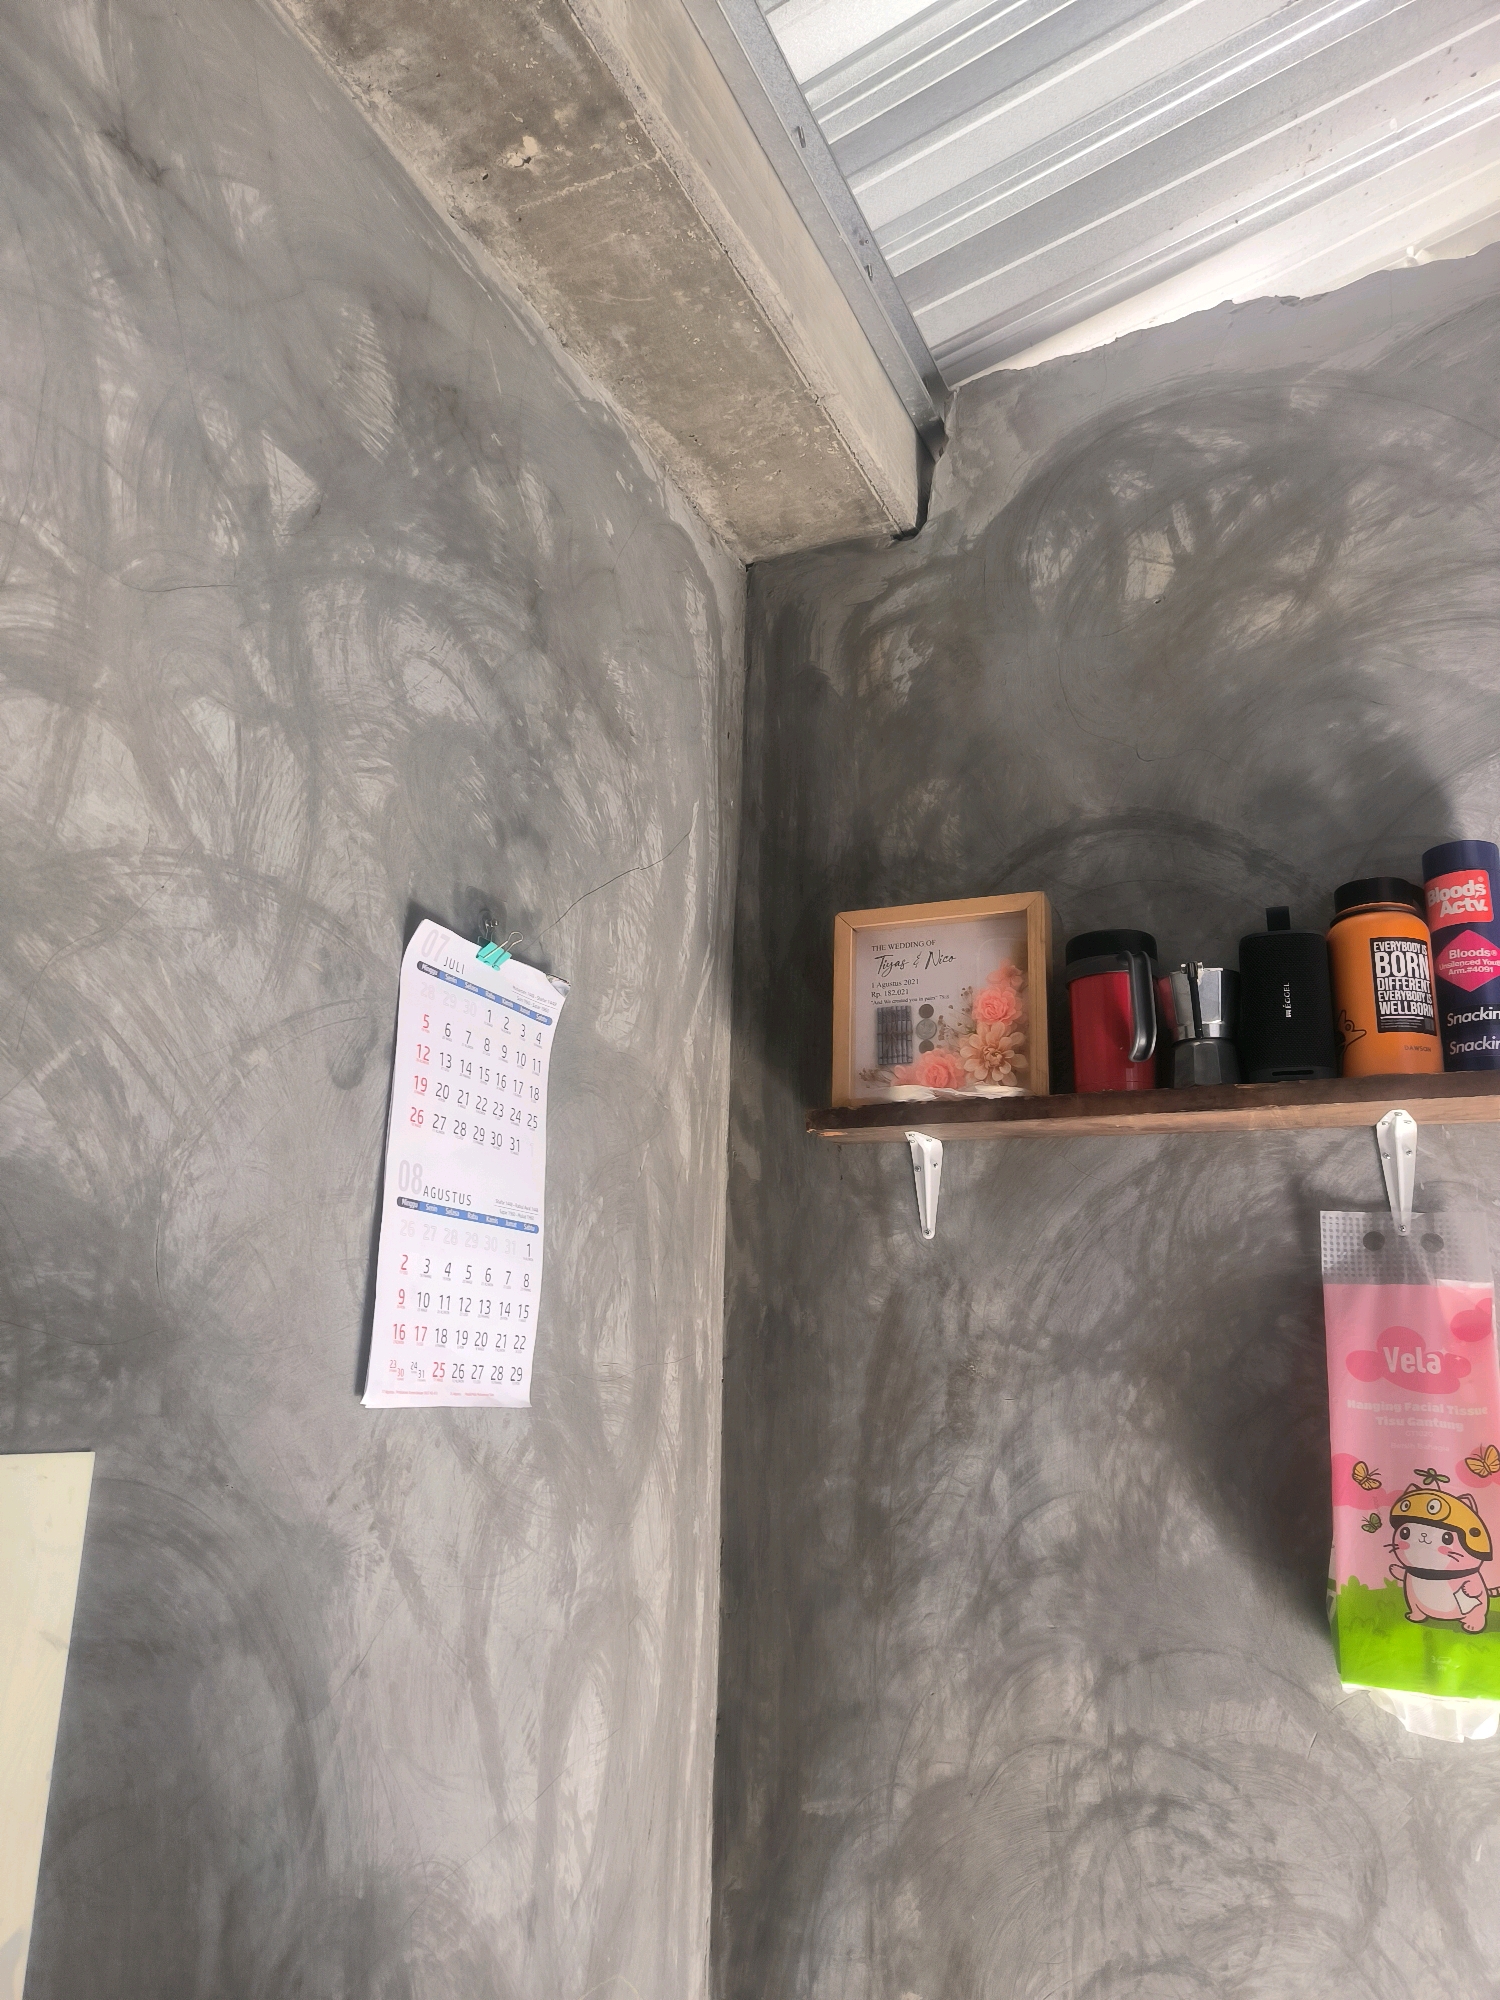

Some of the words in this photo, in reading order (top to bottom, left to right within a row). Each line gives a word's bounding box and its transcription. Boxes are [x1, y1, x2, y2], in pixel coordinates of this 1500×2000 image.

[421, 929, 450, 962] 07
[888, 941, 924, 950] WEDDING
[1374, 941, 1421, 953] EVERYBODY
[1421, 944, 1427, 955] IS
[443, 957, 465, 975] JULI
[874, 954, 909, 977] Tiyas
[925, 950, 956, 969] Nico
[1375, 951, 1430, 980] BORN
[1439, 959, 1480, 970] Unsilenced
[877, 981, 902, 989] Agustus
[1377, 977, 1430, 993] DIFFERENT
[1378, 990, 1425, 1002] EVERYBODY
[1427, 994, 1432, 1004] IS
[1379, 1001, 1433, 1018] WELLBORN
[486, 1009, 492, 1023] 1
[503, 1016, 510, 1031] 2
[520, 1023, 526, 1038] 3
[536, 1032, 543, 1045] 4
[423, 1014, 430, 1029] 5
[444, 1023, 452, 1037] 6
[466, 1030, 472, 1044] 7
[483, 1037, 491, 1052] 8
[501, 1045, 508, 1059] 9
[516, 1051, 526, 1067] 10
[532, 1058, 542, 1074] 11
[417, 1044, 431, 1062] 12
[440, 1052, 452, 1069] 13
[460, 1059, 472, 1076] 14
[479, 1066, 490, 1082] 15
[496, 1072, 507, 1088] 16
[513, 1079, 524, 1095] 17
[530, 1085, 540, 1101] 18
[414, 1075, 428, 1093] 19
[435, 1083, 450, 1100] 20
[457, 1089, 470, 1106] 21
[475, 1095, 488, 1112] 22
[493, 1101, 504, 1118] 23
[510, 1108, 521, 1123] 24
[527, 1113, 538, 1129] 25
[410, 1107, 424, 1124] 26
[432, 1113, 447, 1131] 27
[453, 1120, 467, 1137] 28
[473, 1126, 485, 1142] 29
[490, 1131, 503, 1147] 30
[510, 1137, 520, 1152] 31
[398, 1160, 423, 1195] 08
[423, 1186, 472, 1206] AGUSTUS
[526, 1243, 531, 1257] 1
[401, 1254, 409, 1271] 2
[423, 1258, 431, 1274] 3
[445, 1263, 452, 1277] 4
[465, 1265, 472, 1280] 5
[485, 1268, 492, 1283] 6
[505, 1271, 512, 1285] 7
[523, 1273, 530, 1287] 8
[398, 1288, 405, 1305] 9
[417, 1292, 430, 1308] 10
[439, 1294, 450, 1311] 11
[459, 1297, 472, 1313] 12
[479, 1300, 491, 1315] 13
[499, 1302, 511, 1317] 14
[518, 1304, 529, 1319] 15
[393, 1323, 406, 1341] 16
[415, 1326, 427, 1342] 17
[435, 1328, 448, 1344] 18
[456, 1330, 468, 1346] 19
[474, 1331, 488, 1347] 20
[495, 1333, 507, 1349] 21
[513, 1335, 526, 1350] 22
[389, 1360, 397, 1369] 23
[410, 1361, 418, 1370] 24
[432, 1362, 445, 1378] 25
[452, 1363, 465, 1379] 26
[471, 1364, 484, 1380] 27
[491, 1366, 504, 1381] 28
[510, 1367, 523, 1382] 29
[1383, 1346, 1441, 1375] Vela
[397, 1368, 404, 1378] 30
[418, 1369, 425, 1378] 31
[1347, 1399, 1401, 1413] Hanging
[1405, 1402, 1444, 1414] Facial
[1446, 1405, 1488, 1416] Tissue
[1375, 1416, 1406, 1428] Tisu
[1407, 1417, 1464, 1432] Gantung
